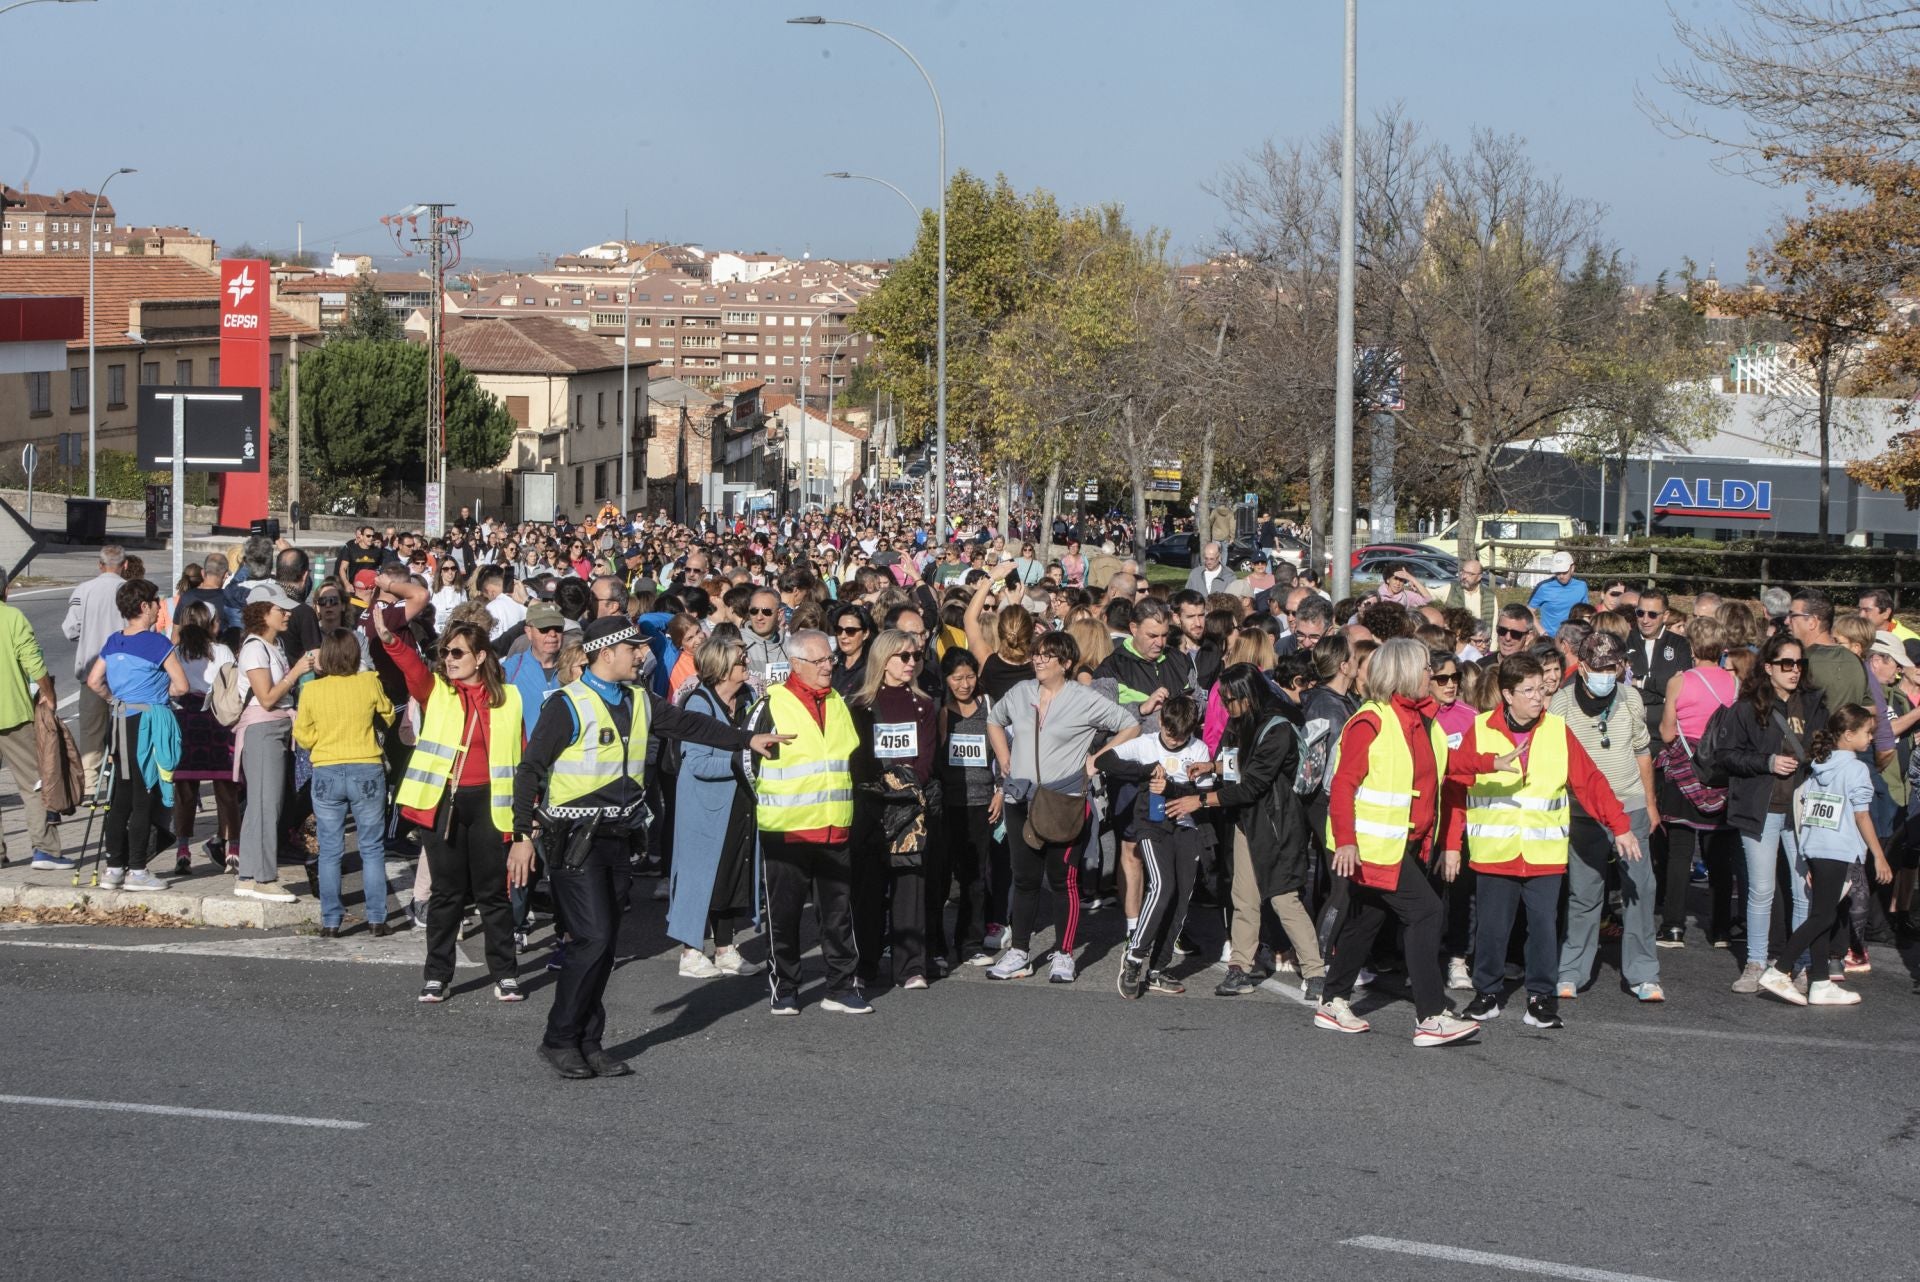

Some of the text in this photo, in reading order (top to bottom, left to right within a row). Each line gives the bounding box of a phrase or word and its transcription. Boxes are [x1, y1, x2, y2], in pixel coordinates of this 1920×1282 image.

[223, 313, 259, 328] CEPSA
[1653, 477, 1772, 511] ALDI
[881, 734, 910, 749] 4756
[952, 744, 981, 758] 2900
